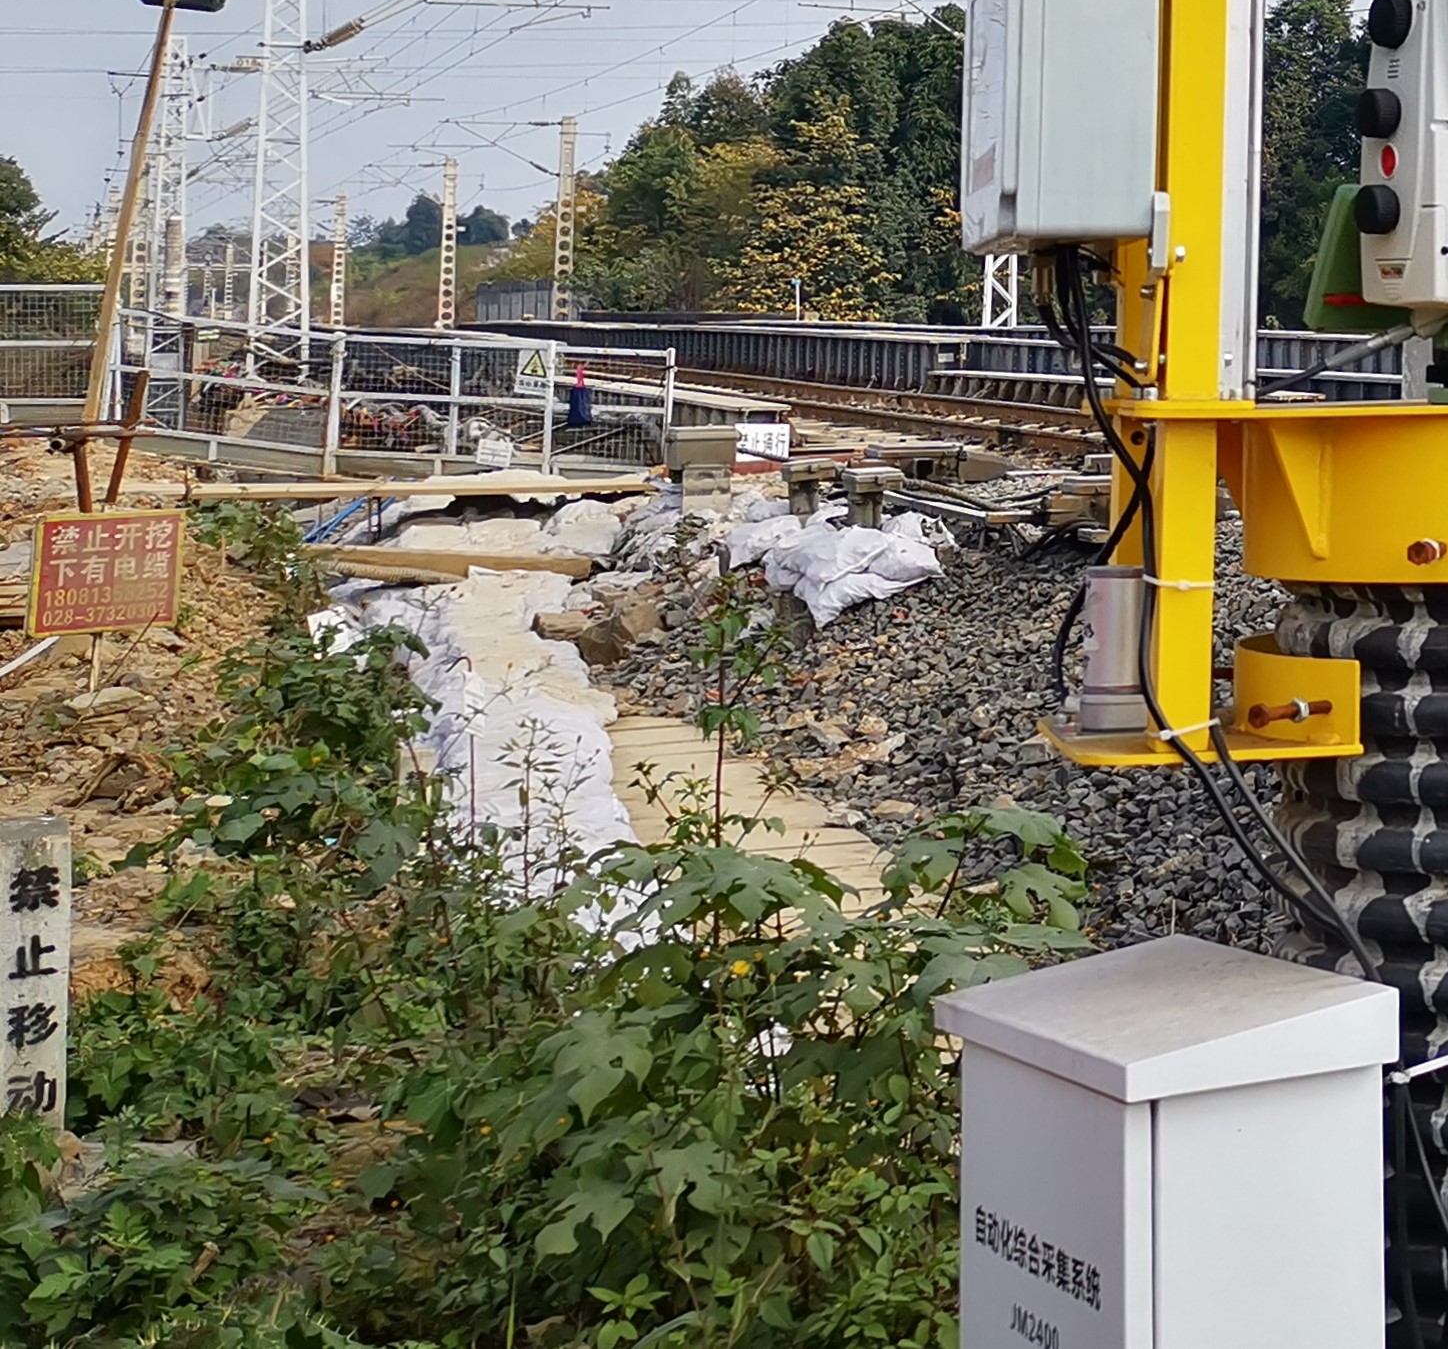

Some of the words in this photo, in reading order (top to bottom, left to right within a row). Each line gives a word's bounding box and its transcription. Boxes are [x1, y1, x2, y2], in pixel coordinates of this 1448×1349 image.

[51, 521, 174, 555] 禁止开挖
[50, 551, 171, 587] 下有电缆
[42, 602, 168, 627] 028-37320302
[8, 865, 60, 1114] 禁止移动
[975, 1204, 1102, 1312] 自动化综合采集系统
[1010, 1302, 1060, 1349] JM2400
